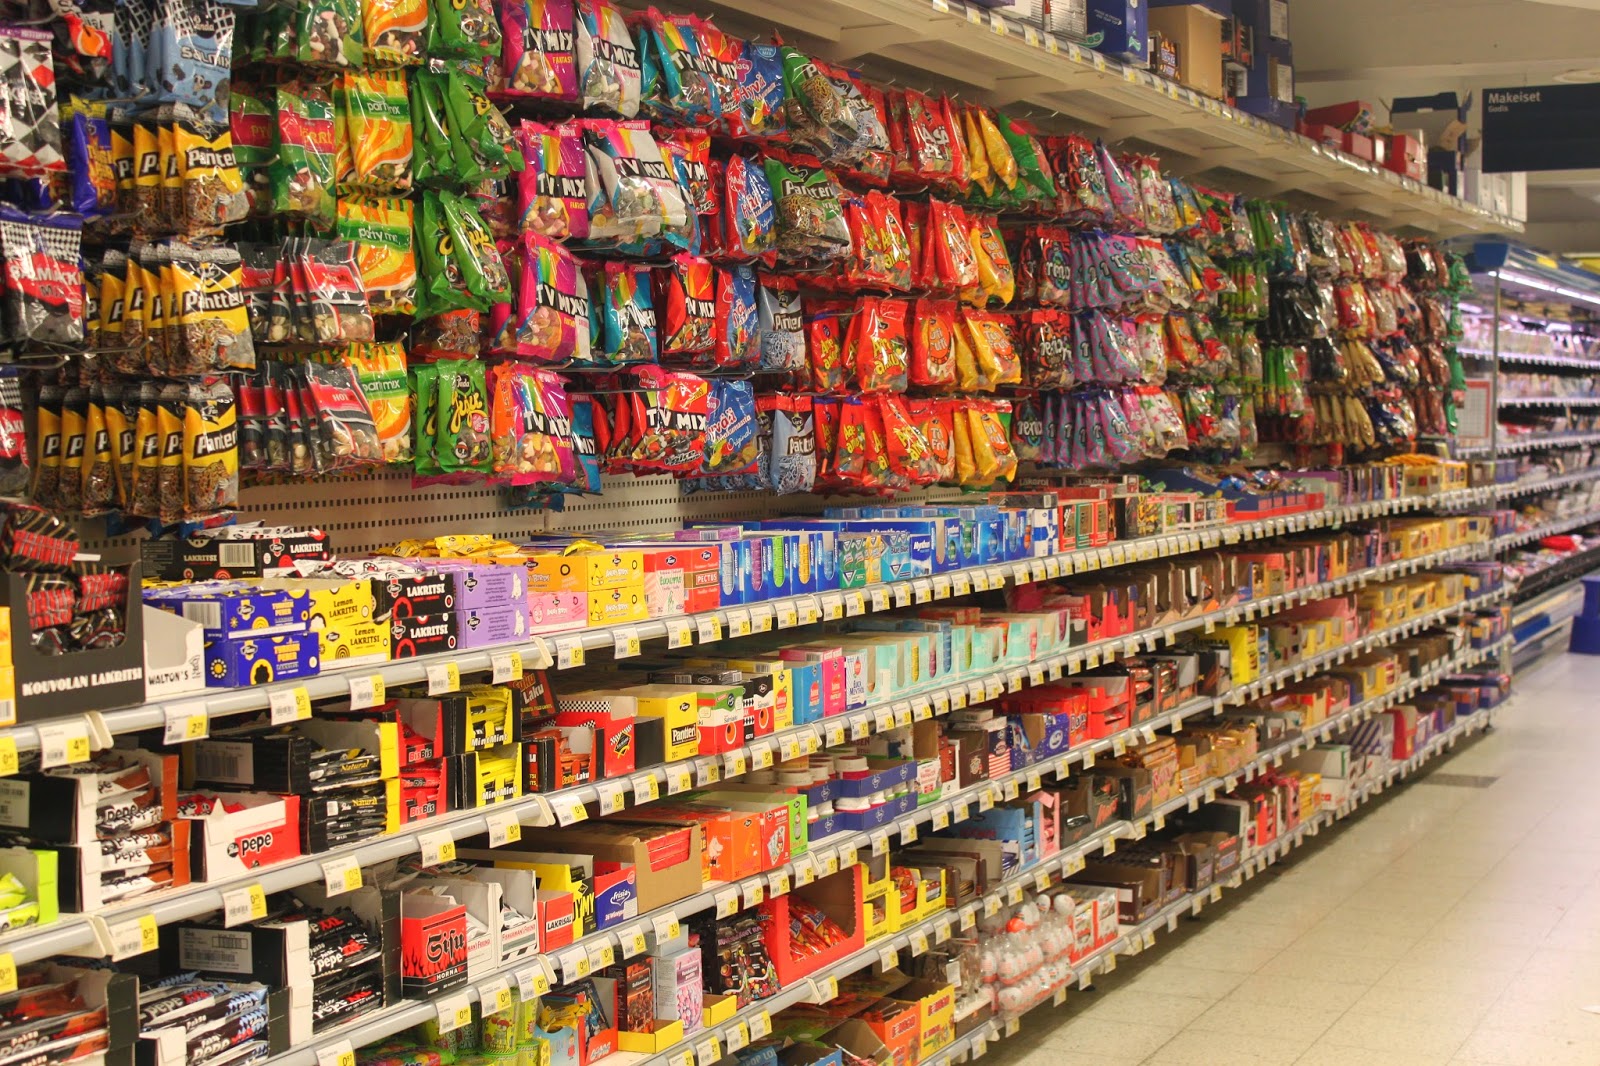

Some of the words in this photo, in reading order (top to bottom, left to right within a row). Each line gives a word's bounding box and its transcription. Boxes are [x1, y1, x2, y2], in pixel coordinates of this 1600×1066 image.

[612, 42, 639, 68] MIX
[1488, 92, 1541, 104] Makeiset
[1488, 105, 1509, 113] Godis
[615, 158, 640, 175] TV
[643, 162, 670, 180] MIX
[537, 174, 558, 194] TV
[562, 178, 586, 198] MIX
[536, 284, 555, 306] TV
[384, 378, 401, 391] mix
[332, 392, 348, 402] HOT
[523, 411, 543, 432] TV
[646, 408, 673, 428] TV
[677, 413, 707, 432] MIX
[290, 542, 323, 554] LAKRITSI
[183, 553, 218, 563] LAKRITSI
[697, 572, 718, 584] PECTUS
[407, 583, 446, 598] LAKRITSI
[333, 598, 354, 608] Lemon
[329, 605, 358, 618] LAKRITSI
[354, 628, 376, 636] Lemon
[410, 624, 449, 639] LAKRITSI
[350, 635, 380, 646] LAKRITSI
[22, 675, 89, 697] KOUVOLAN
[91, 667, 143, 686] LAKRITSI
[148, 671, 189, 686] WALTON'S
[522, 683, 544, 705] Laku
[673, 725, 697, 743] Pantteri
[408, 748, 433, 763] BisBis
[340, 759, 370, 772] Natural
[482, 786, 518, 801] MintMint
[352, 797, 378, 806] Natural
[410, 803, 435, 818] BisBis
[241, 832, 274, 857] pepe
[612, 888, 630, 901] frisia
[547, 915, 573, 931] LAKRISAL
[316, 952, 343, 974] pepe
[436, 968, 459, 982] HORNA
